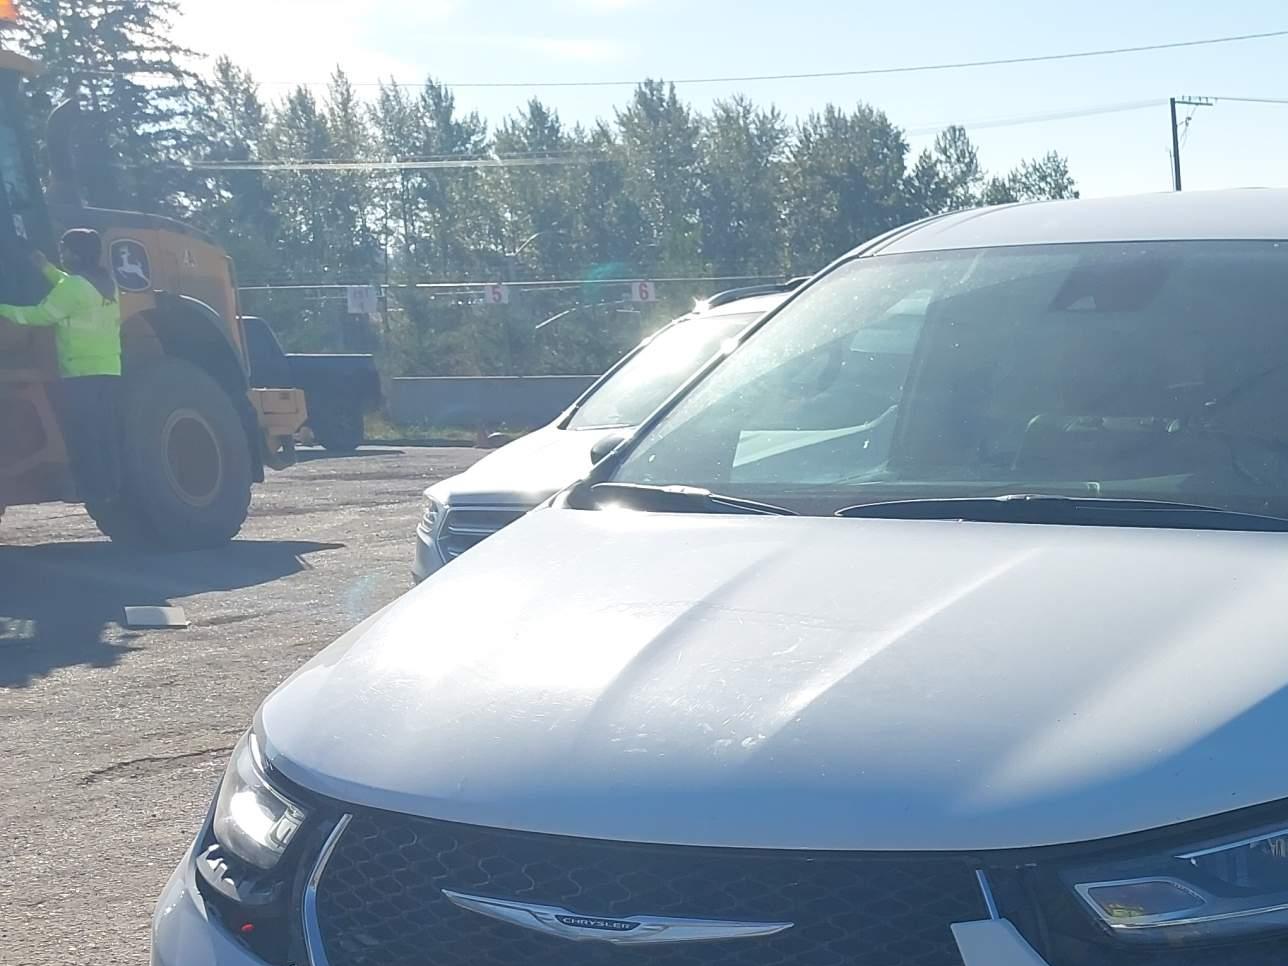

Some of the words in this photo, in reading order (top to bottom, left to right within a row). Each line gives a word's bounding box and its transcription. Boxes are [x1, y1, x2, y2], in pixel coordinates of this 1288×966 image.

[491, 287, 502, 303] 5
[639, 283, 649, 300] 6
[562, 917, 631, 930] CHRYSLER
